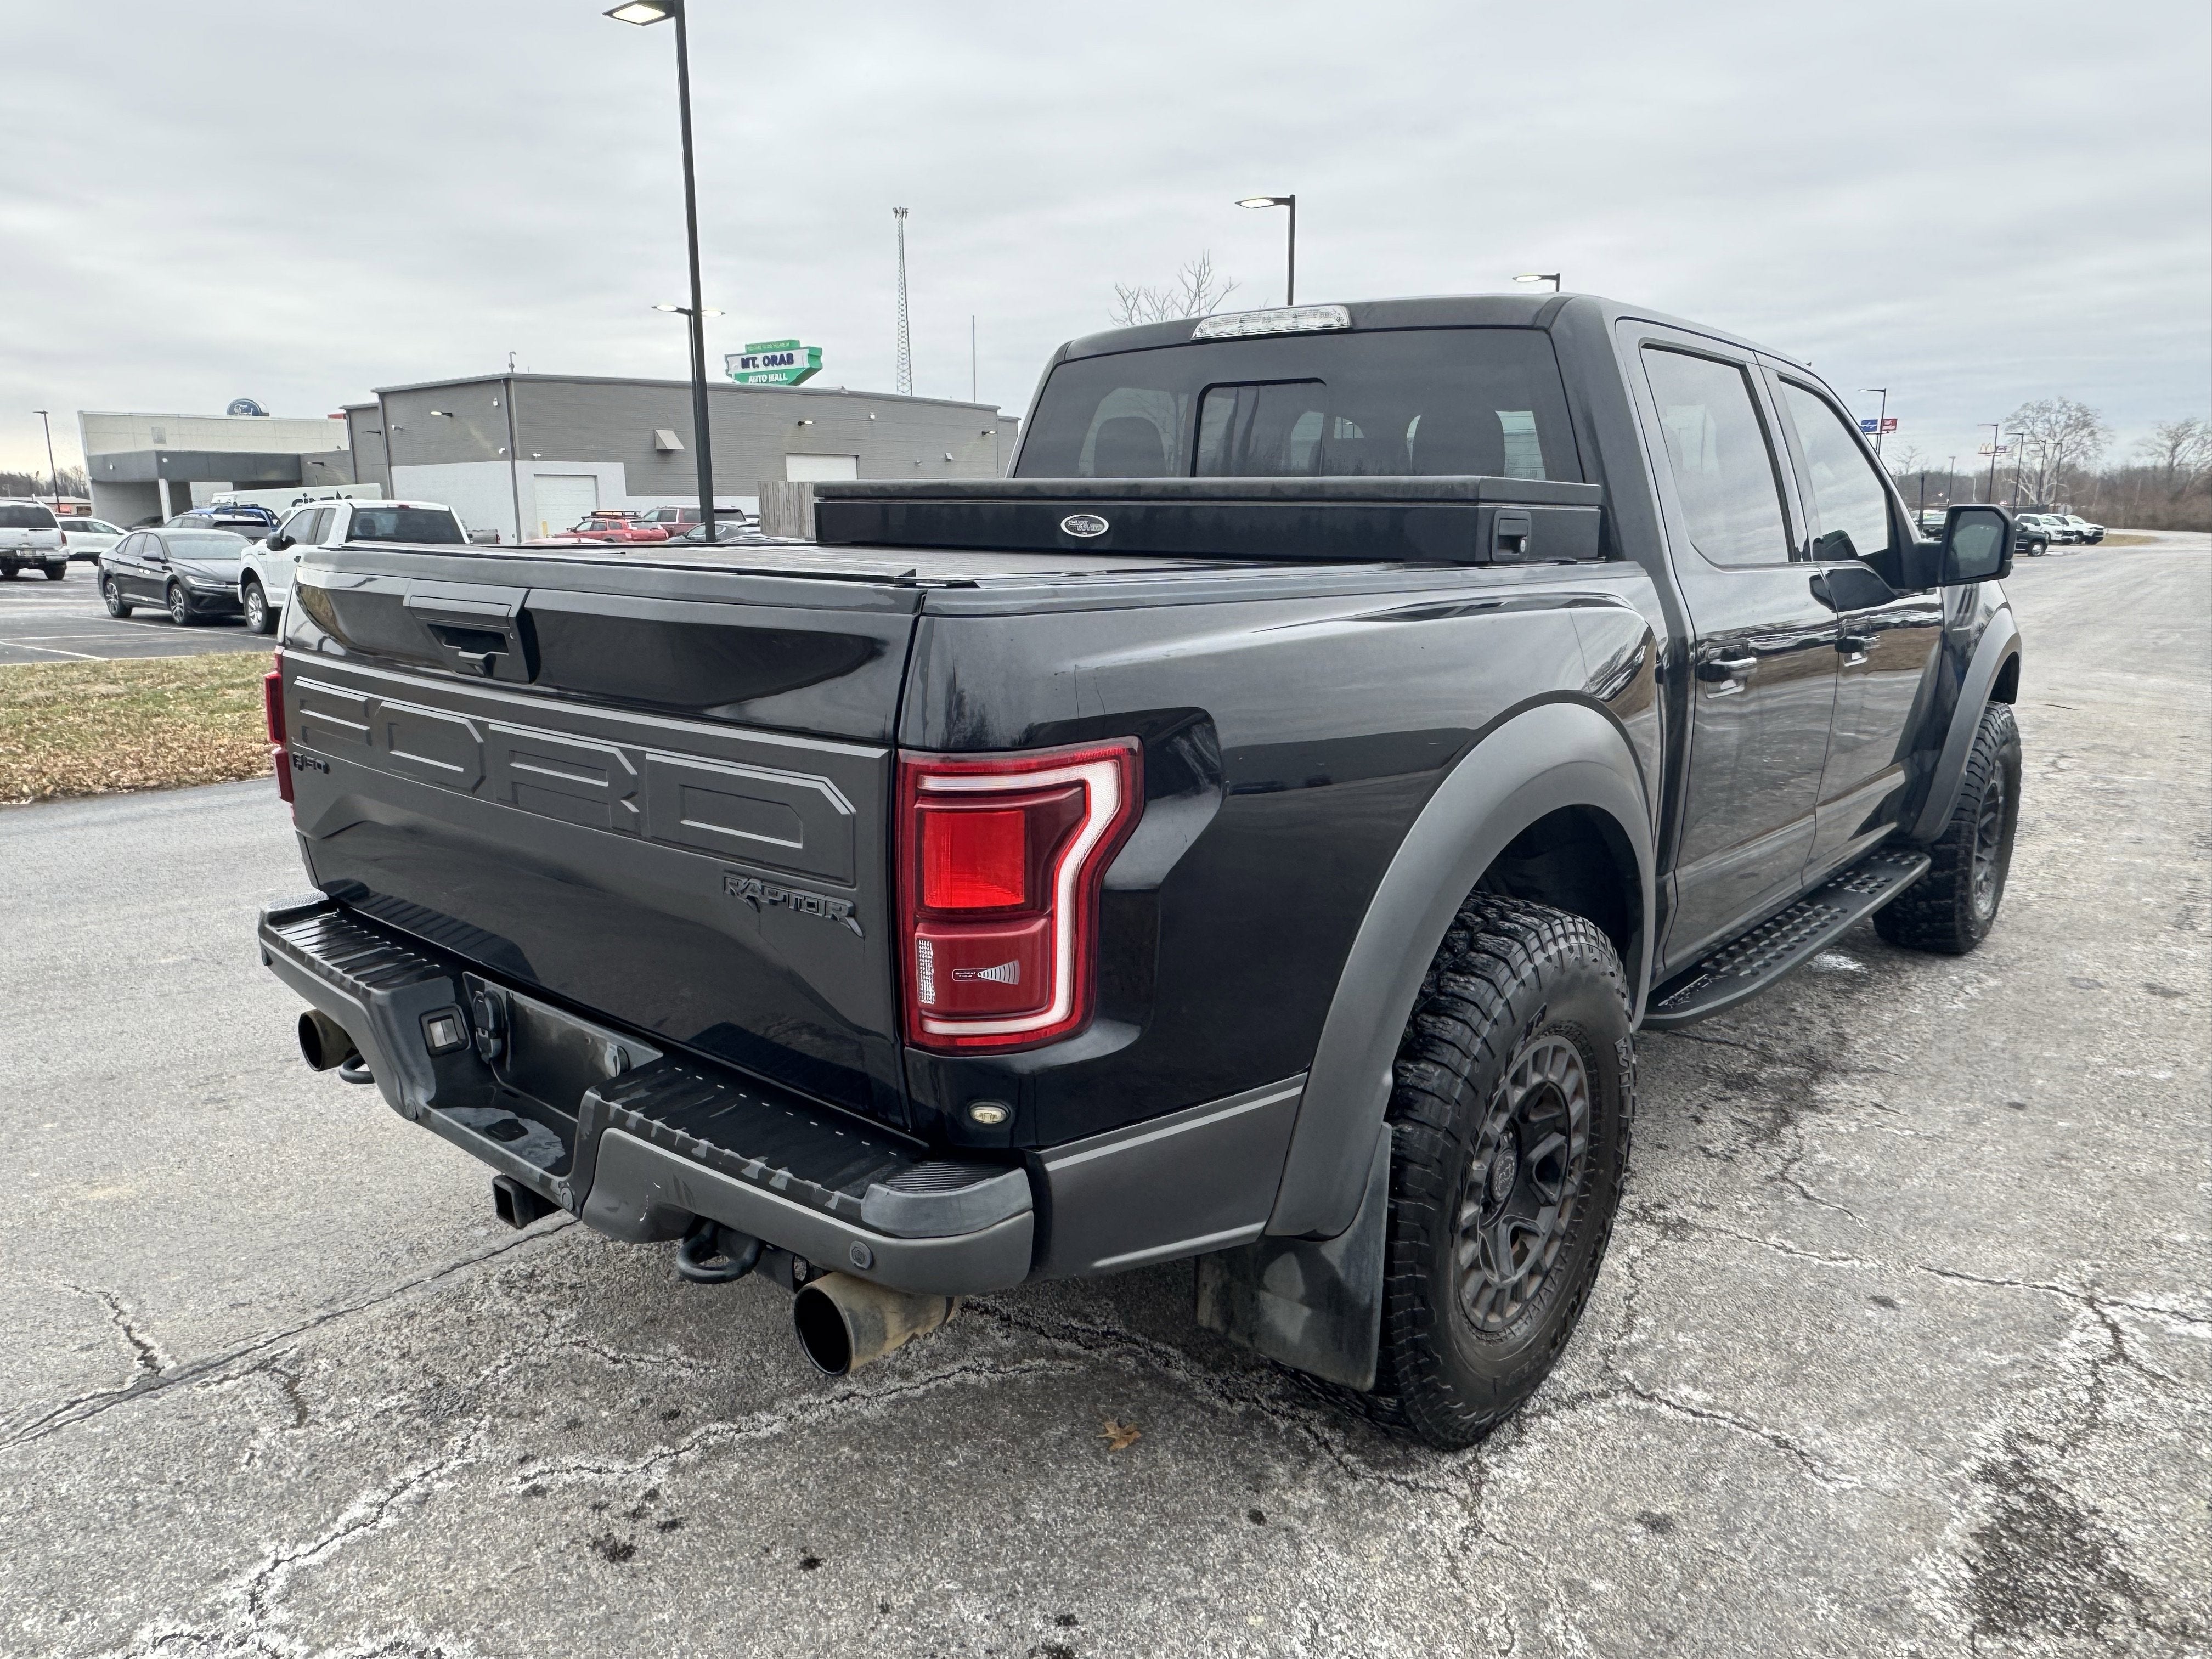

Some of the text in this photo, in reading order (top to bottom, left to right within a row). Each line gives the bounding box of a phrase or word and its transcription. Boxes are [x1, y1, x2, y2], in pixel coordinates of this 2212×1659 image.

[741, 353, 794, 369] MT. ORAB
[748, 374, 768, 383] AUTO
[291, 676, 857, 891] FORD
[723, 877, 865, 939] RAPTOR
